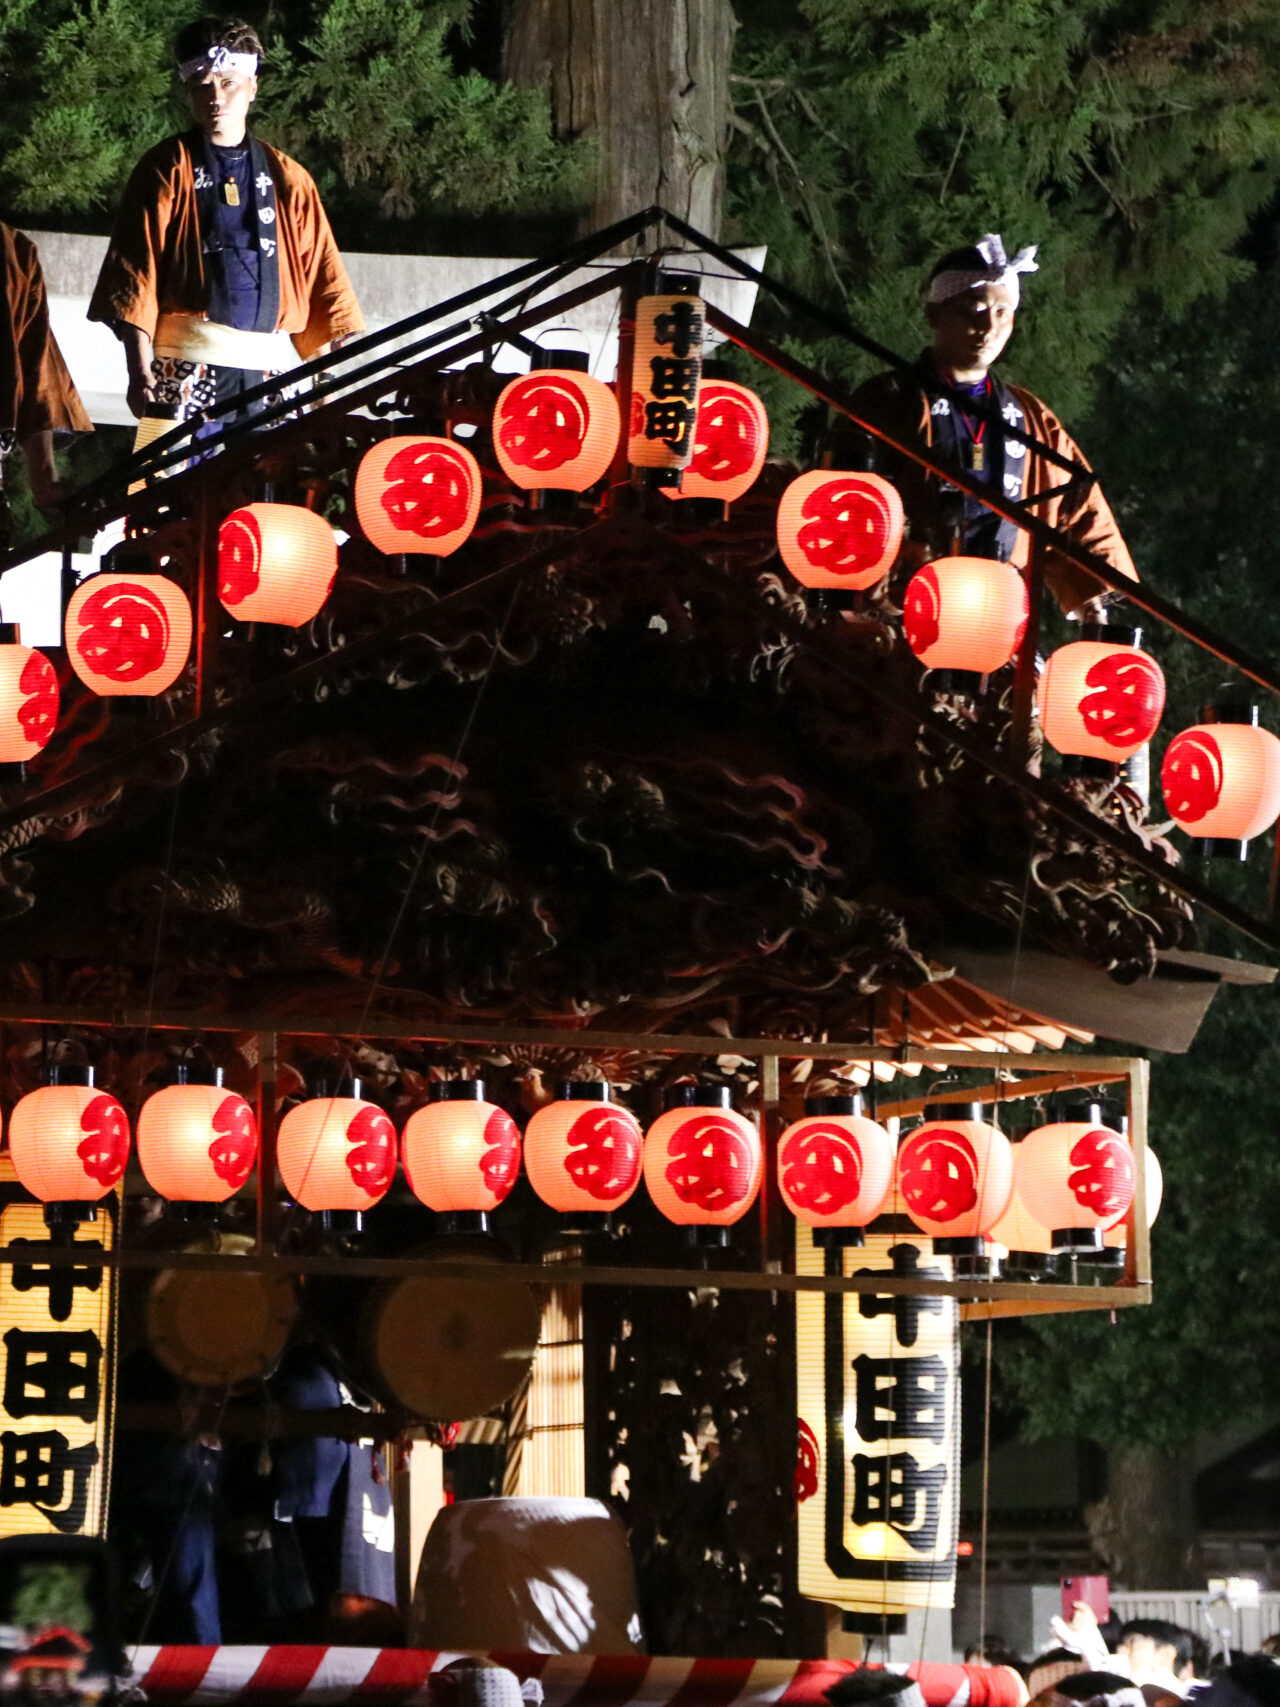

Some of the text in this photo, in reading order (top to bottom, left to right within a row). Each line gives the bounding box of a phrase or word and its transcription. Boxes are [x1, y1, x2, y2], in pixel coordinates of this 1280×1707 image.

[254, 171, 281, 259] 中田町
[645, 301, 703, 457] 中田町
[1001, 402, 1027, 497] 中田町
[851, 1243, 947, 1553] 中田町
